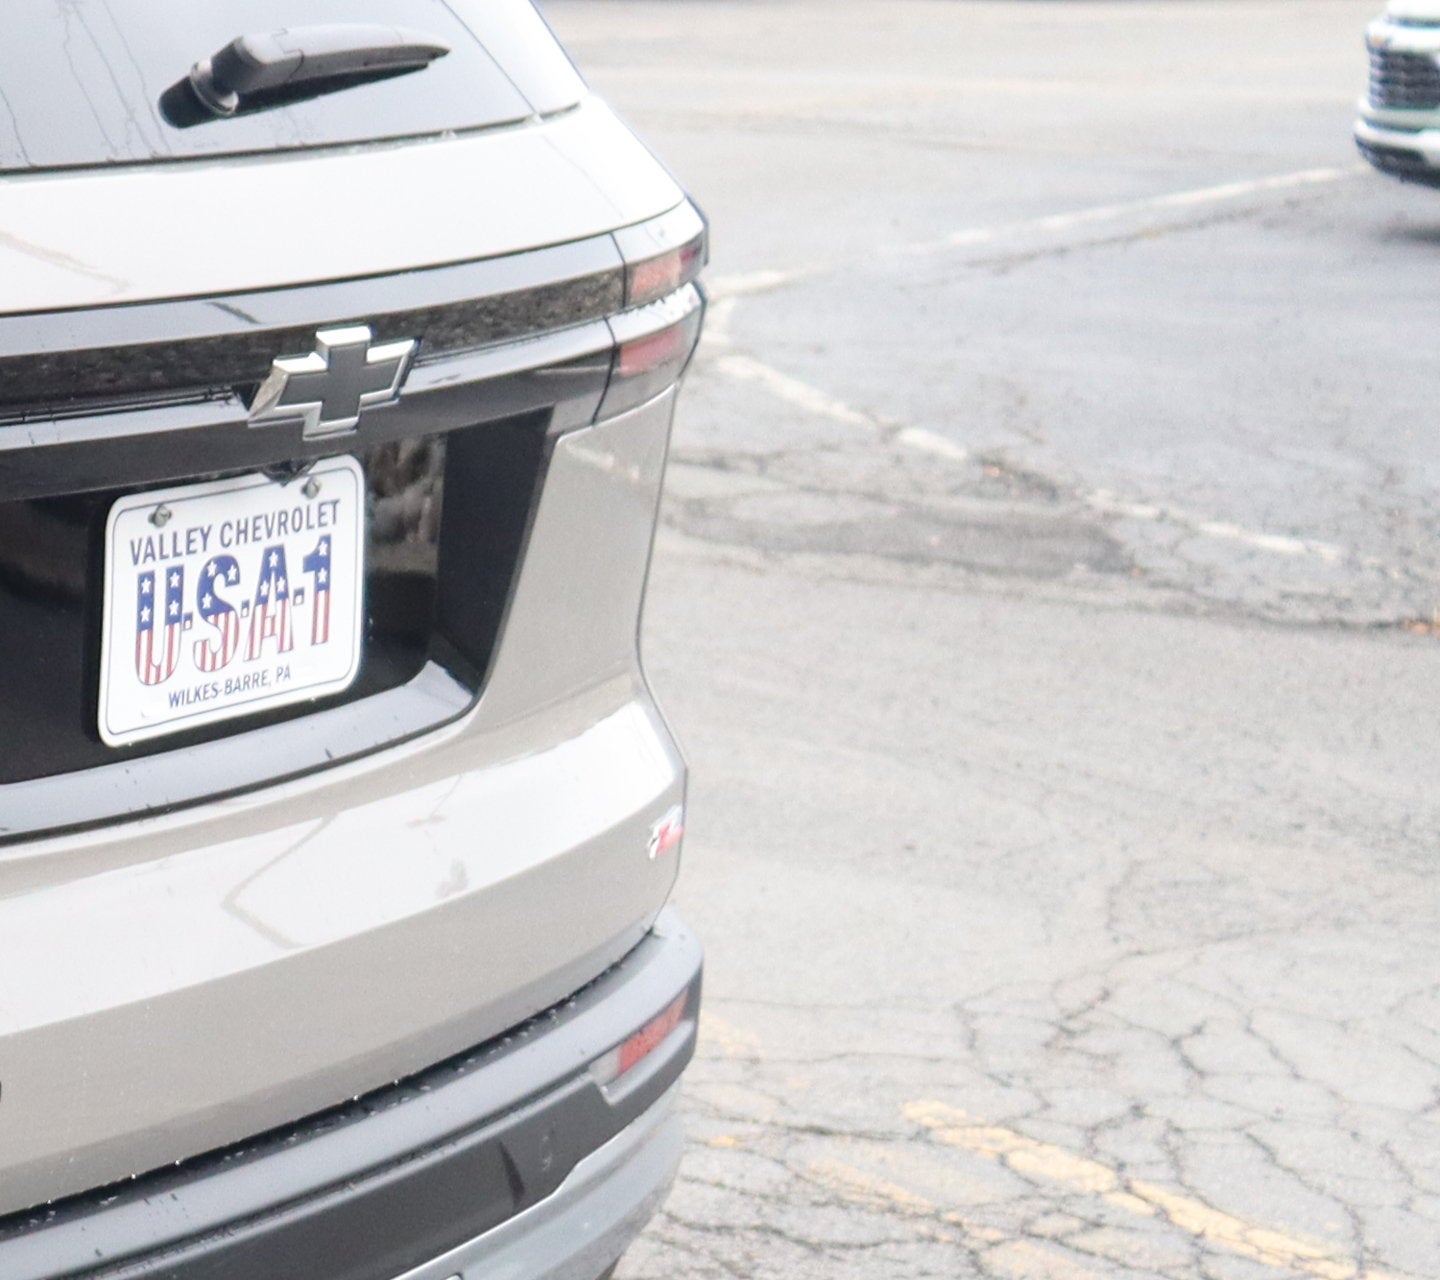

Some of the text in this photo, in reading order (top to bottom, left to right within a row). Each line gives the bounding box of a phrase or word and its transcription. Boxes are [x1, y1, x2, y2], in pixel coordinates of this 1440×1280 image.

[130, 498, 340, 566] VALLEY CHEVROLET
[169, 664, 291, 708] WILKES-BARRE, PA
